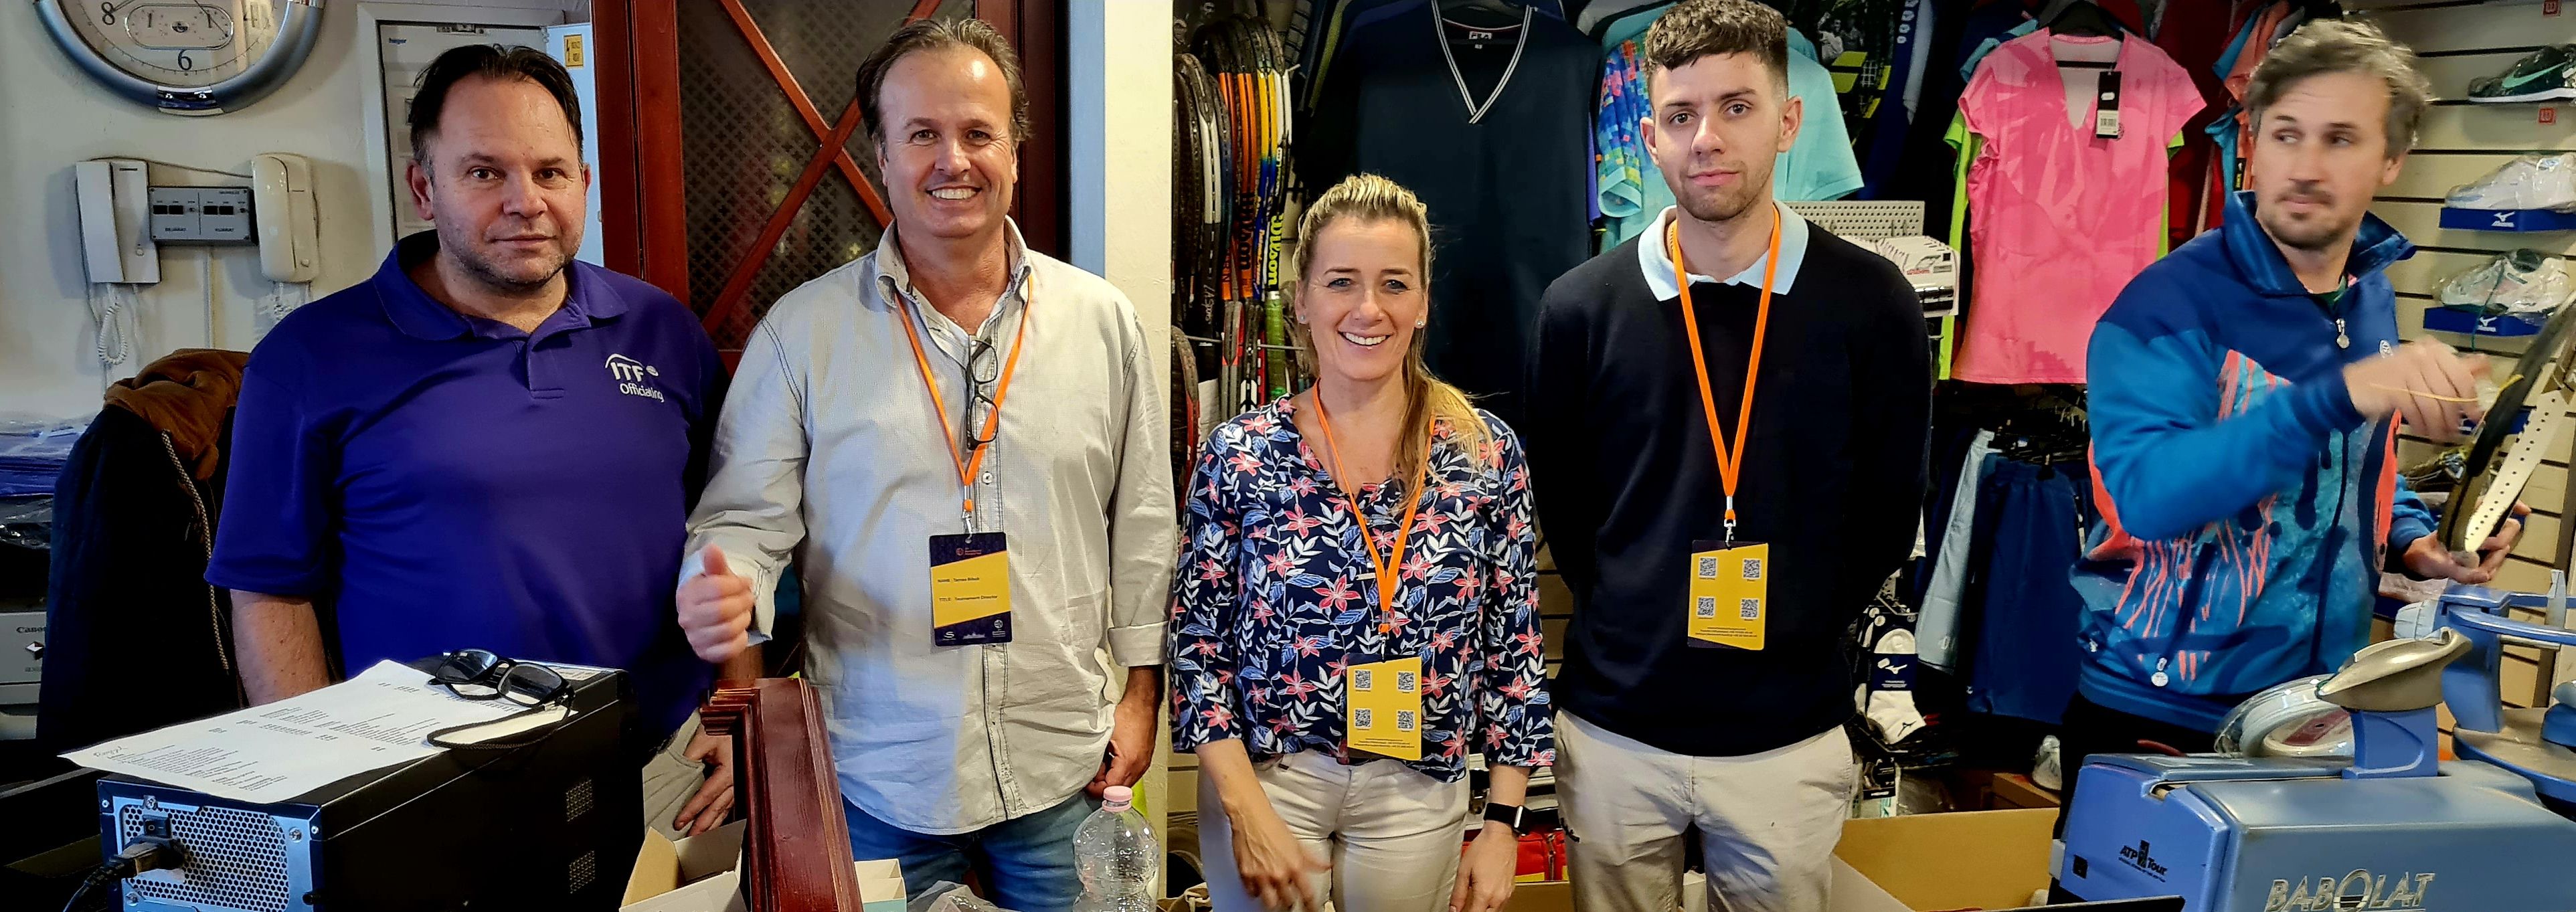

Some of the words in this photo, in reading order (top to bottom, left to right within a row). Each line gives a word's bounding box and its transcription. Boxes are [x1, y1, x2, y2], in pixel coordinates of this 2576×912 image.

[177, 49, 193, 71] 6
[1268, 213, 1284, 285] Wilson
[610, 362, 645, 382] ITF
[620, 382, 665, 403] Officiating
[2120, 845, 2138, 860] ATP
[2264, 869, 2436, 912] BABOLAT
